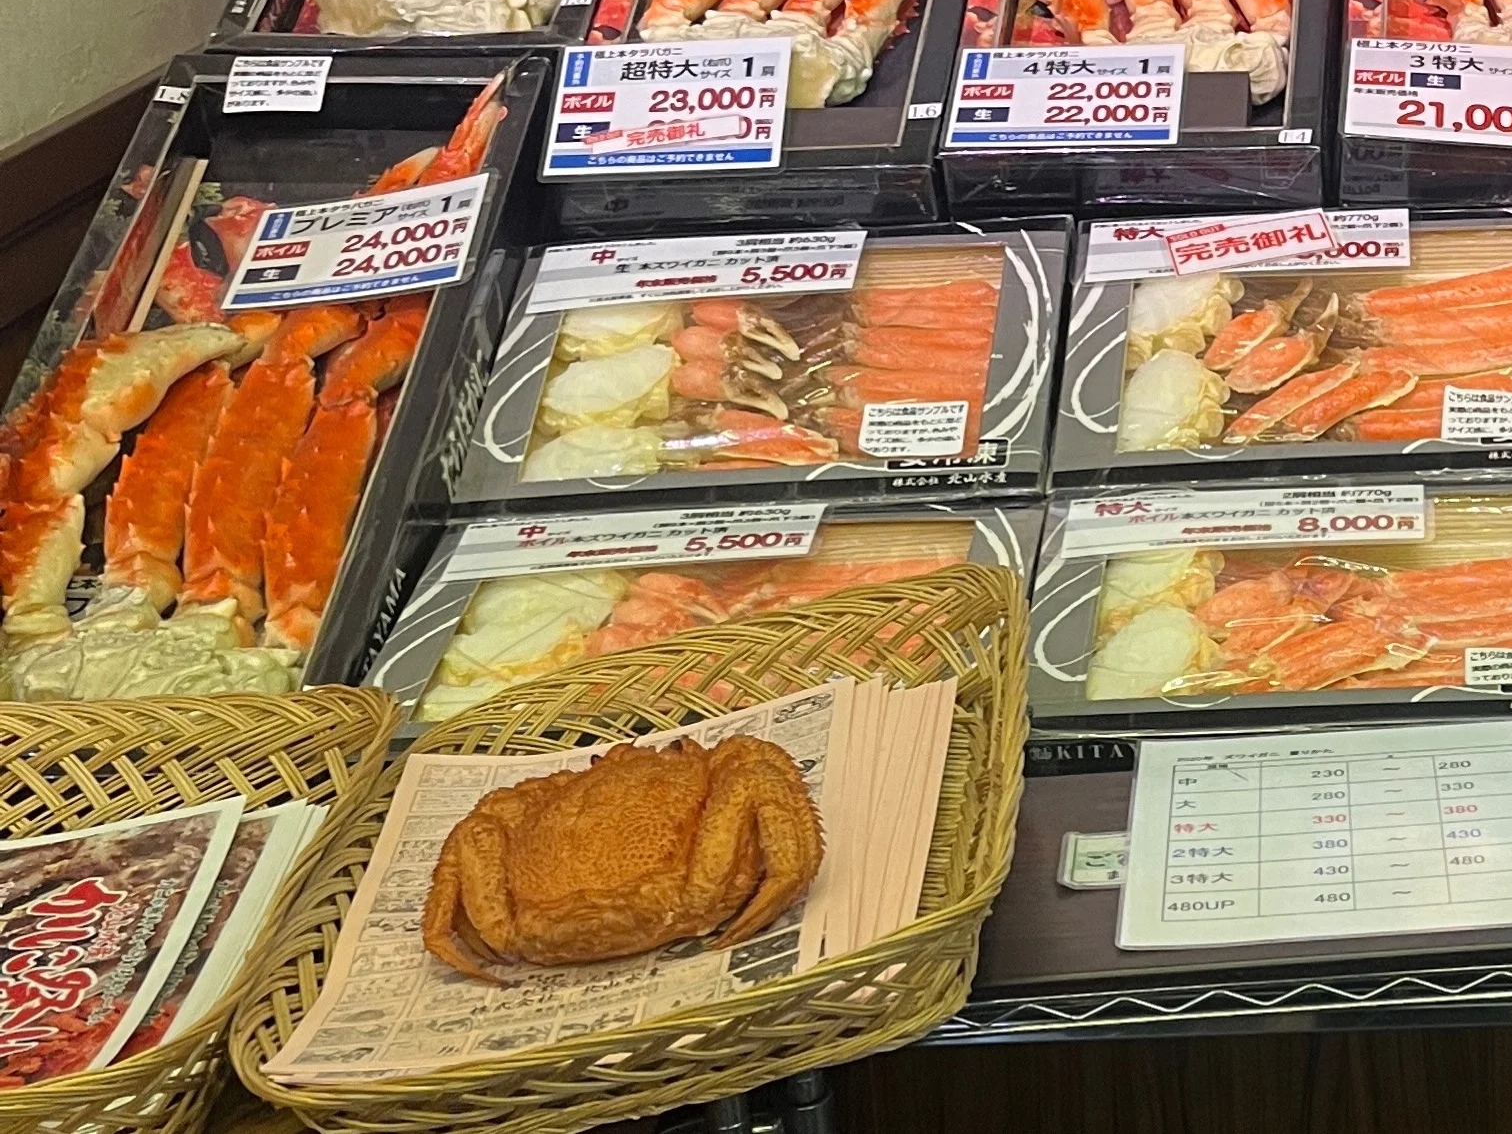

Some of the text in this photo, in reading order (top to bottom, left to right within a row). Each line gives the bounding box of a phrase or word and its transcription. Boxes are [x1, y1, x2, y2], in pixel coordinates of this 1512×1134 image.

[620, 59, 698, 81] 超特大
[741, 56, 754, 77] 1
[1138, 58, 1150, 74] 1
[1356, 72, 1445, 87] ボイル 生
[964, 86, 1012, 97] ボイル
[563, 95, 613, 110] ボイル
[913, 105, 937, 117] 1.6
[973, 109, 992, 121] 生
[573, 124, 591, 138] 生
[626, 122, 706, 147] 完売御礼
[291, 206, 399, 235] プレミア
[440, 196, 453, 213] 1
[1112, 228, 1164, 242] 特大
[255, 244, 308, 259] ボイル
[1177, 224, 1327, 264] 完売御礼
[590, 249, 616, 264] 中
[260, 269, 280, 281] 生
[1094, 501, 1152, 517] 特大
[518, 525, 547, 539] 中
[1311, 769, 1345, 778] 230
[1176, 799, 1197, 810] 大
[1311, 791, 1345, 801] 280
[1440, 782, 1474, 791] 330
[1173, 822, 1218, 834] 特大
[1312, 814, 1347, 824] 330
[1443, 804, 1478, 815] 380
[1172, 847, 1234, 858] 2特大
[1312, 839, 1348, 849] 380
[1446, 829, 1482, 839] 430
[1170, 872, 1234, 884] 3特大
[1313, 865, 1349, 875] 430
[1449, 855, 1485, 866] 480
[1167, 893, 1350, 912] 480UP 480
